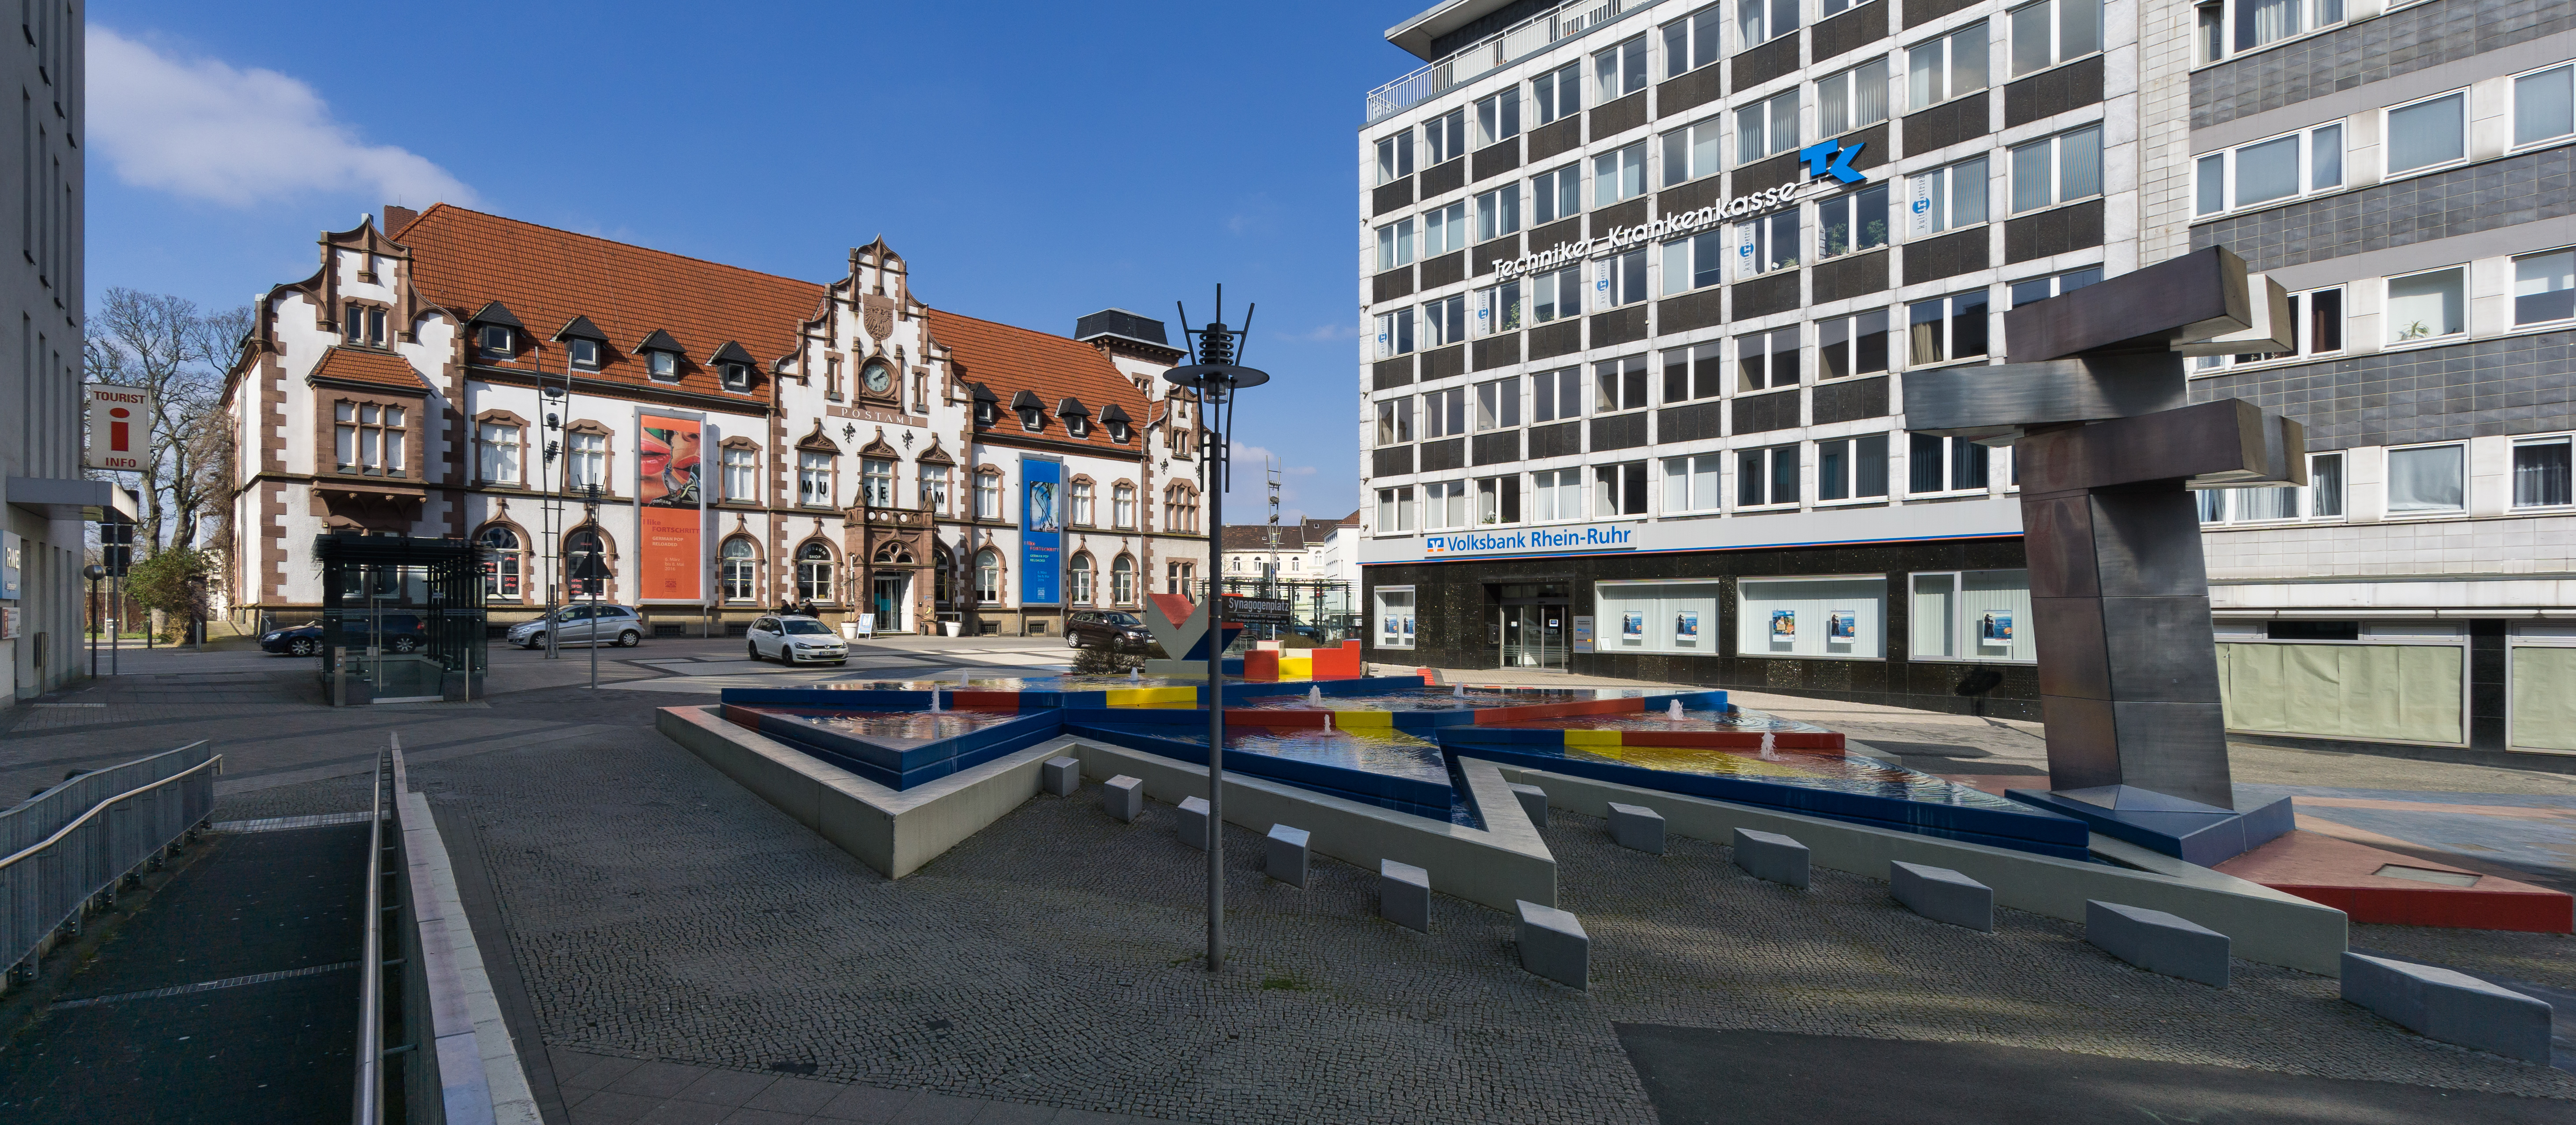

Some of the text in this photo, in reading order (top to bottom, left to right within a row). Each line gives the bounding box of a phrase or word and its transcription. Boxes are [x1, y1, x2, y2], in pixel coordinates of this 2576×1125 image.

[1492, 182, 1797, 279] Techniker Krankenkasse
[93, 391, 146, 404] TOURIST
[842, 408, 914, 425] POSTAMT
[106, 457, 136, 467] INFO
[1447, 526, 1631, 551] Volksbank Rhein-Ruhr
[6, 547, 20, 569] RWE
[804, 547, 826, 555] MUSEUM
[1229, 597, 1289, 613] Synagogenplatz
